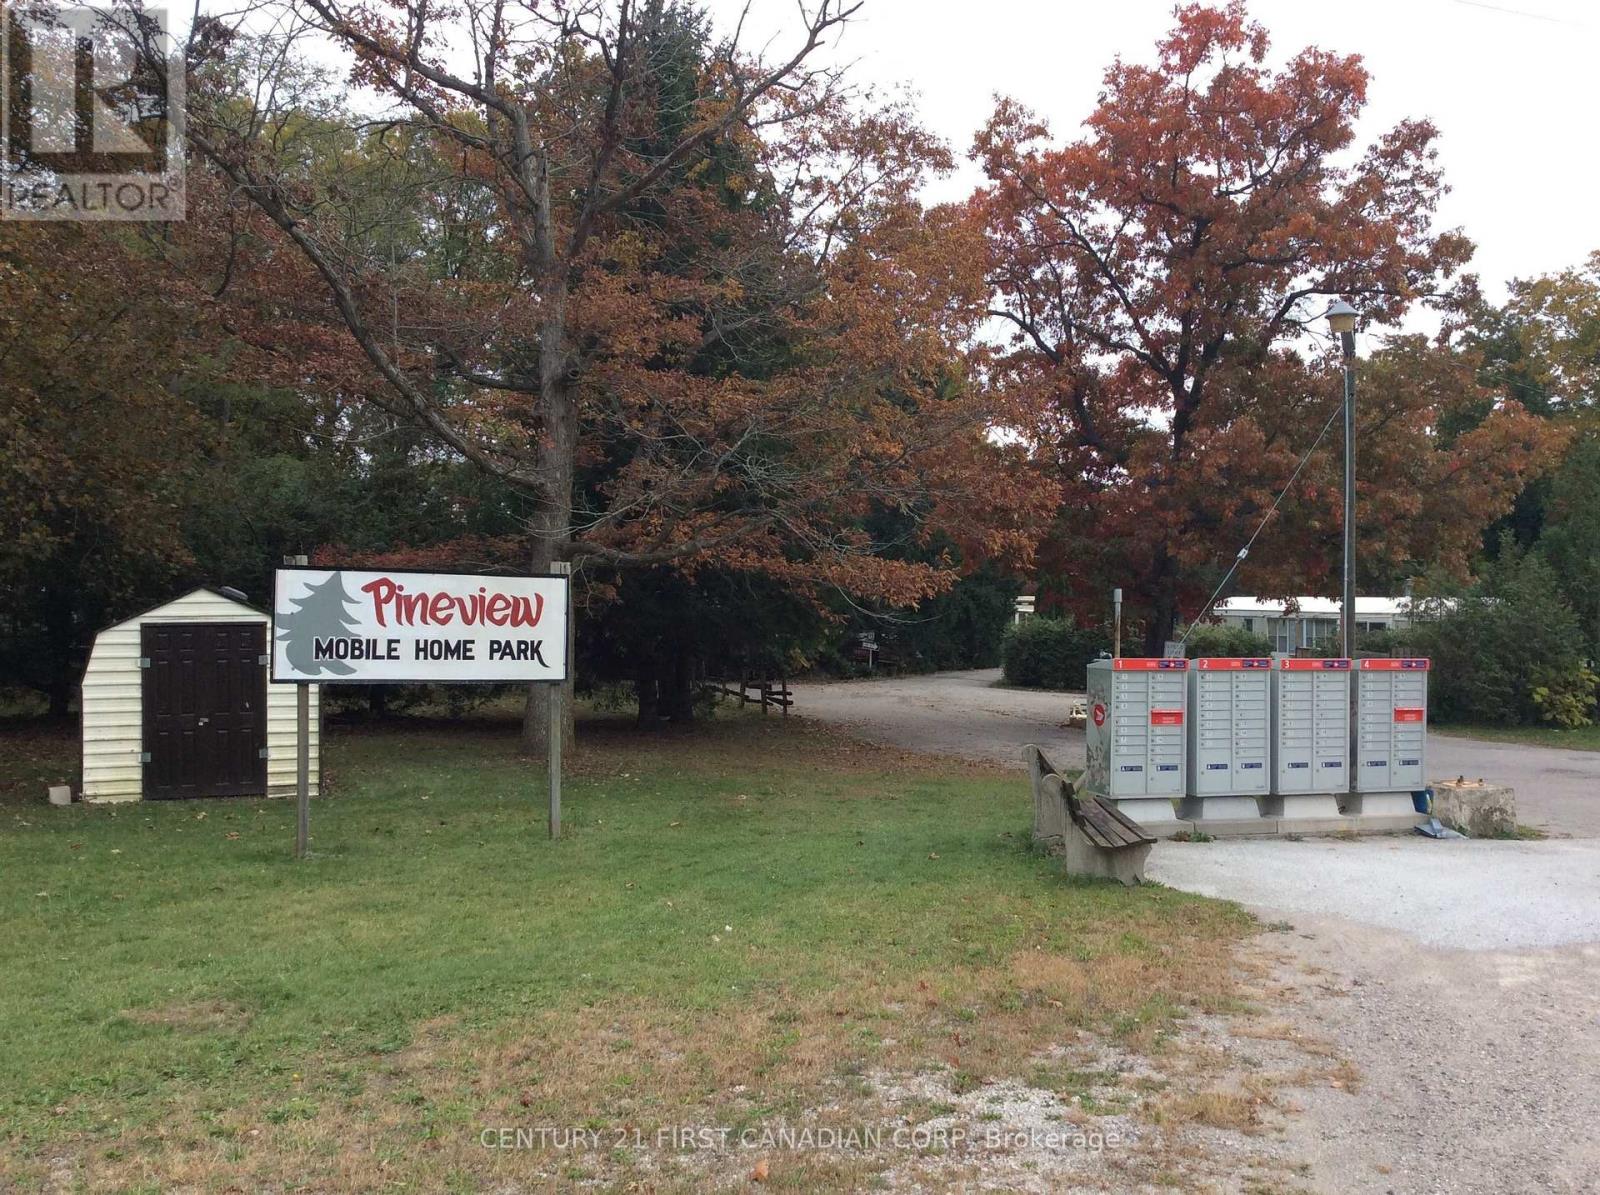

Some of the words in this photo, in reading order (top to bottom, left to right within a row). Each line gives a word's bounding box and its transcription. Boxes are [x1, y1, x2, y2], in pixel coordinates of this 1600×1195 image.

[361, 577, 544, 628] Pineview
[314, 638, 400, 660] MOBILE
[415, 639, 475, 660] HOME
[489, 639, 550, 668] PARK
[1202, 659, 1209, 669] 2
[1284, 660, 1290, 669] 3
[1364, 660, 1370, 669] 4
